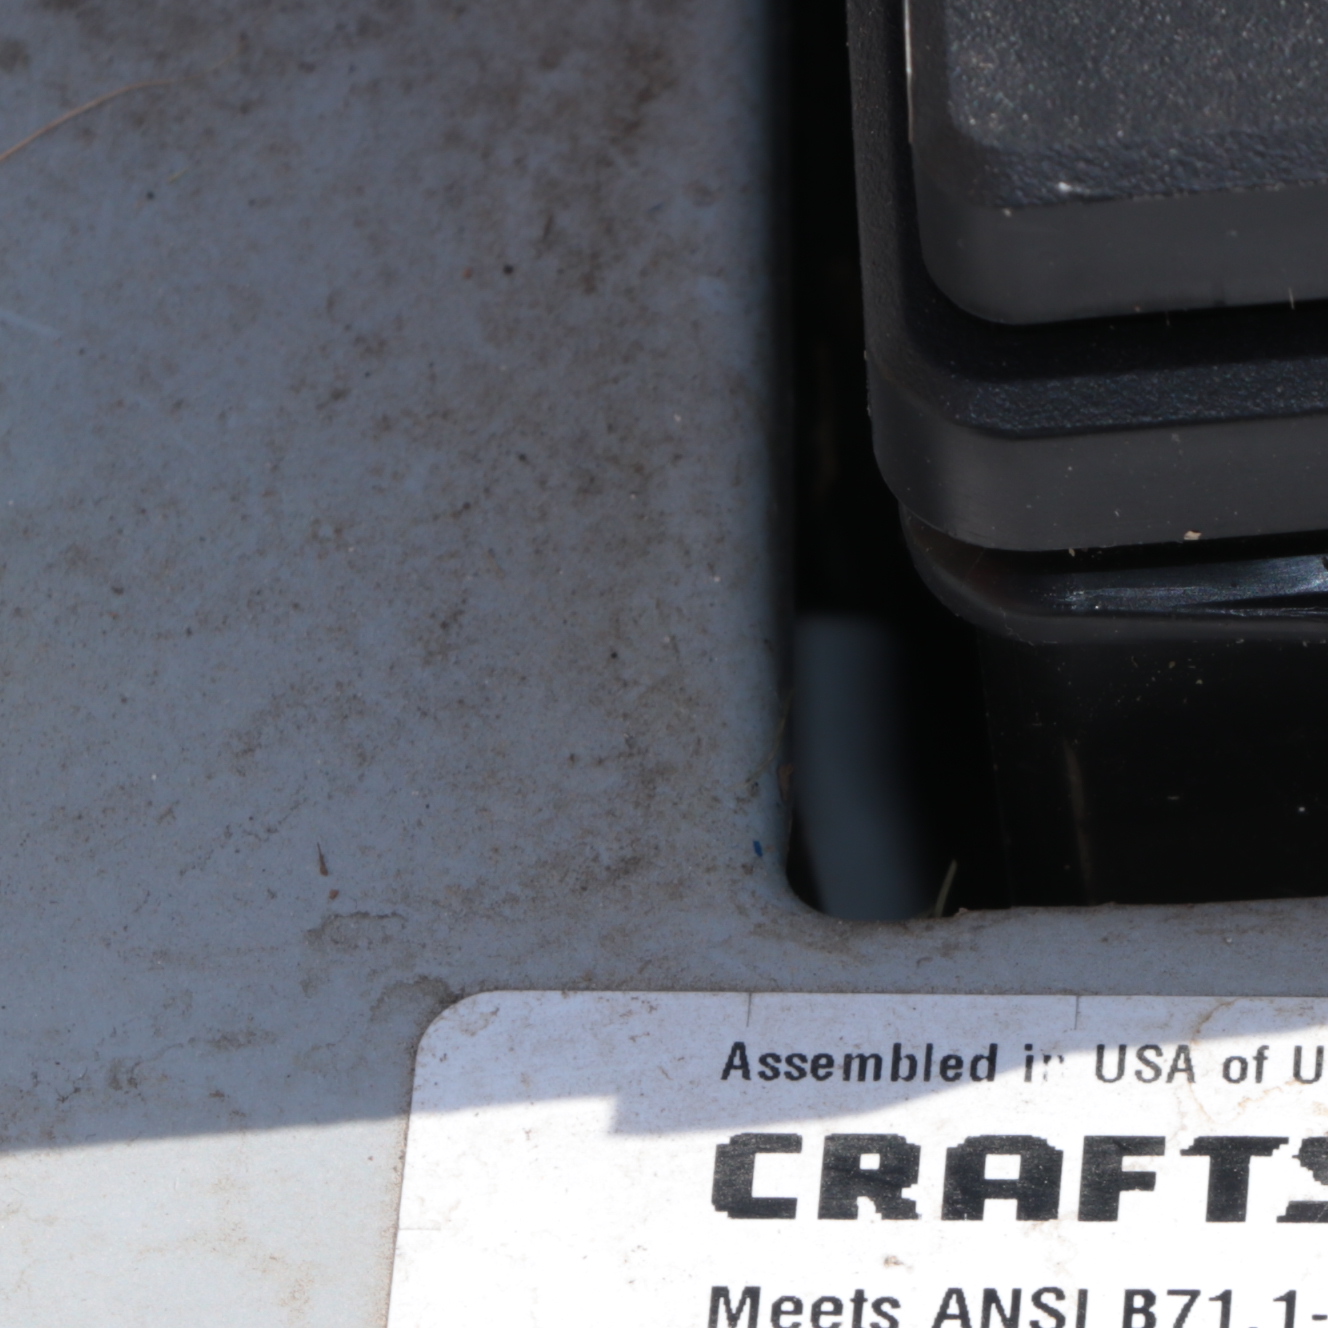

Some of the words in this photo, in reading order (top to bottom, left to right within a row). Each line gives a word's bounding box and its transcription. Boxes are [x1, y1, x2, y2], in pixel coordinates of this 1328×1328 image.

[720, 1041, 999, 1083] Assembled
[1094, 1043, 1196, 1084] USA
[1221, 1044, 1270, 1085] of
